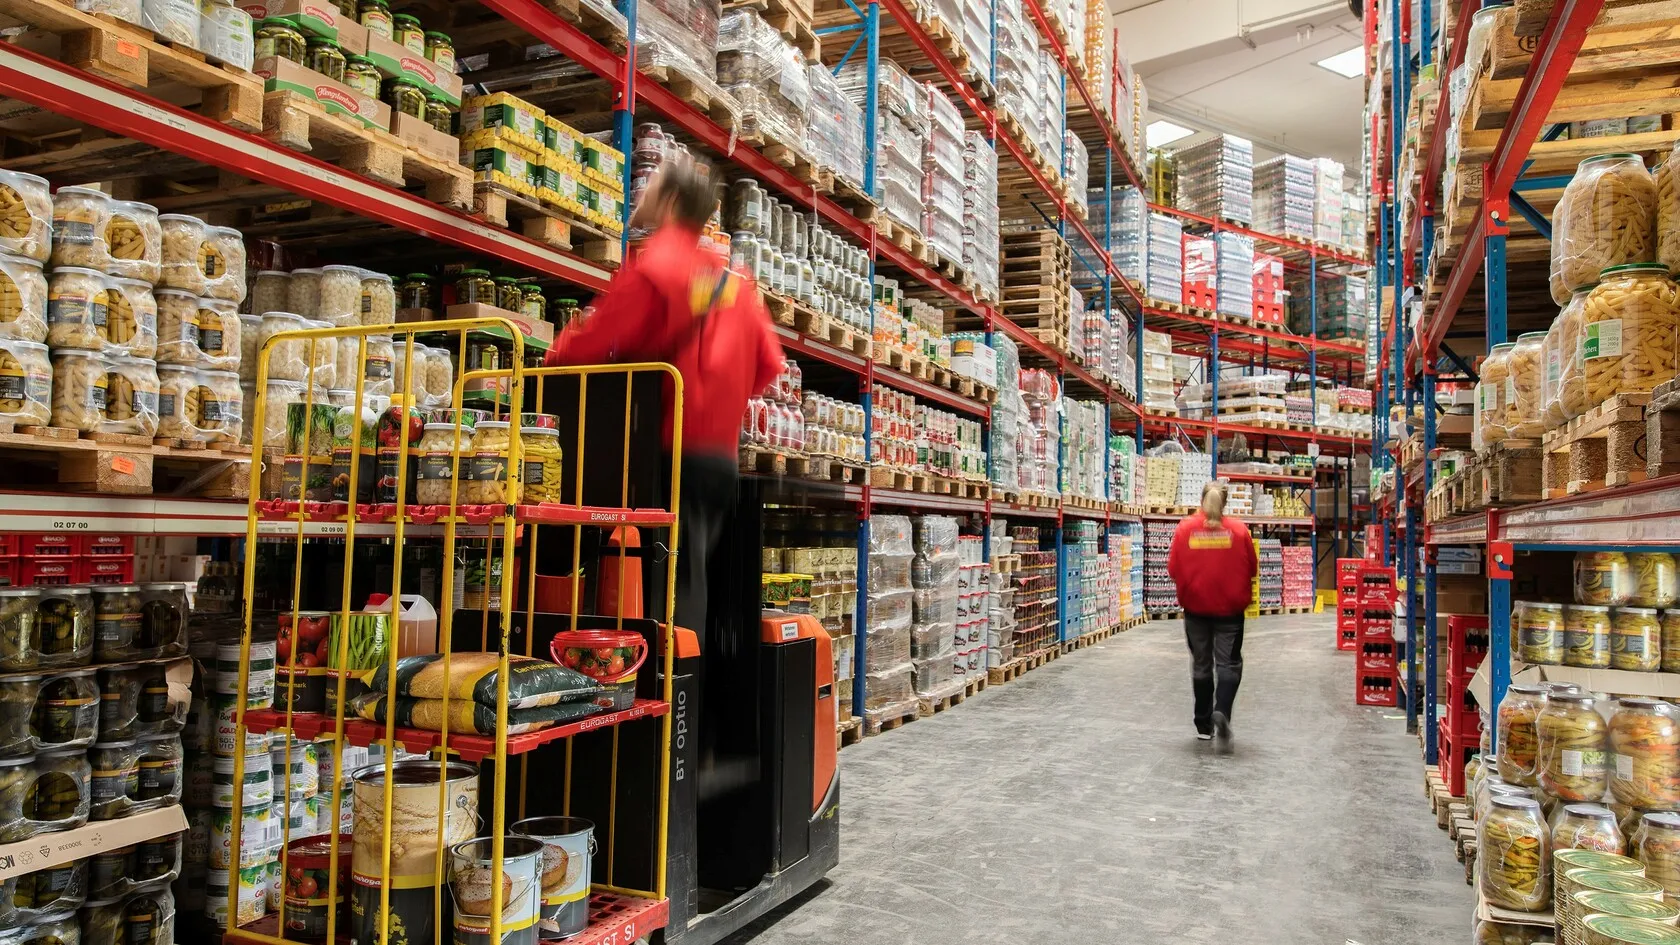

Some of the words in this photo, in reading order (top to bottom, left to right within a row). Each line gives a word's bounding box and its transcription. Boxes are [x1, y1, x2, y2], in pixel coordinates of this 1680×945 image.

[318, 88, 358, 111] Hengstenberg
[580, 714, 618, 730] EUROGAST
[676, 691, 687, 749] optio
[676, 757, 684, 781] BT
[354, 874, 382, 886] euroga
[624, 922, 635, 941] SI
